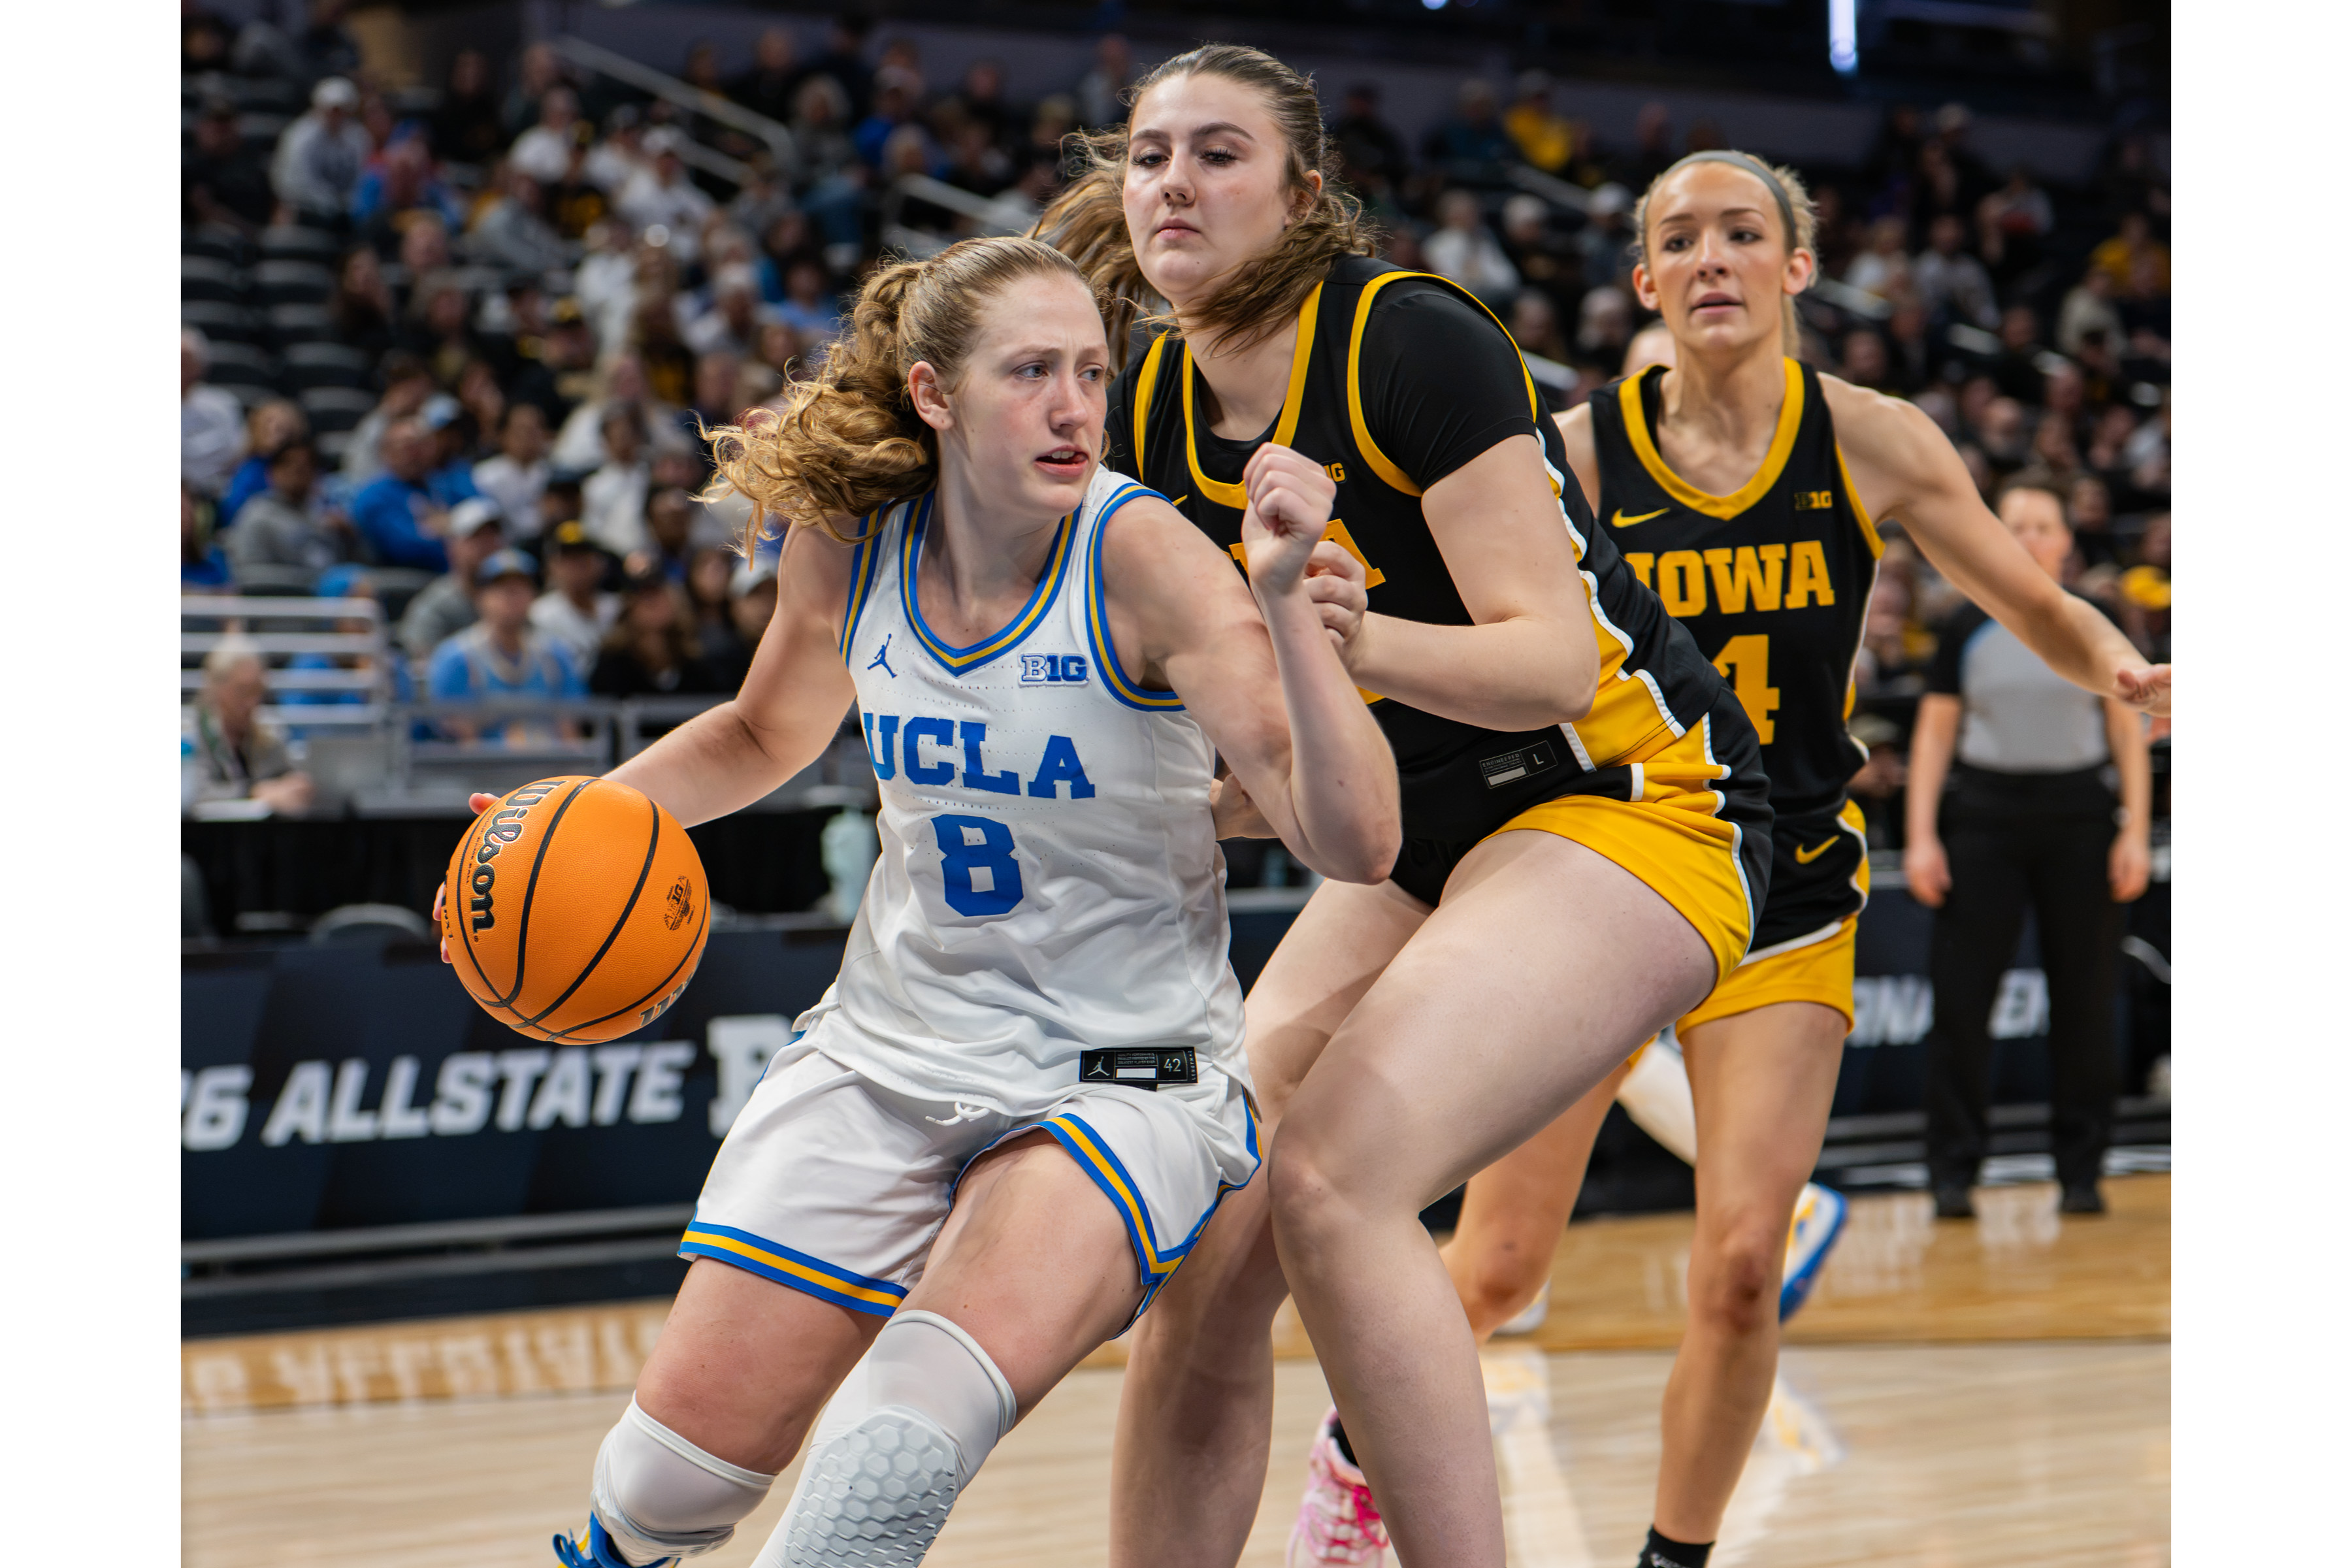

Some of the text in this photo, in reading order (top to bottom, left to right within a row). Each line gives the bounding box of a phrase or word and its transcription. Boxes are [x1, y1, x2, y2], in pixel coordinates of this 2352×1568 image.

[1624, 540, 1835, 618] IOWA
[863, 712, 1096, 800] UCLA
[1482, 753, 1520, 768] ENGINEERED
[1533, 753, 1544, 765] L
[470, 780, 570, 934] Wilson
[930, 813, 1024, 917] 8
[181, 1063, 255, 1152] 6
[260, 1040, 698, 1147] ALLSTATE
[1163, 1058, 1182, 1073] 42
